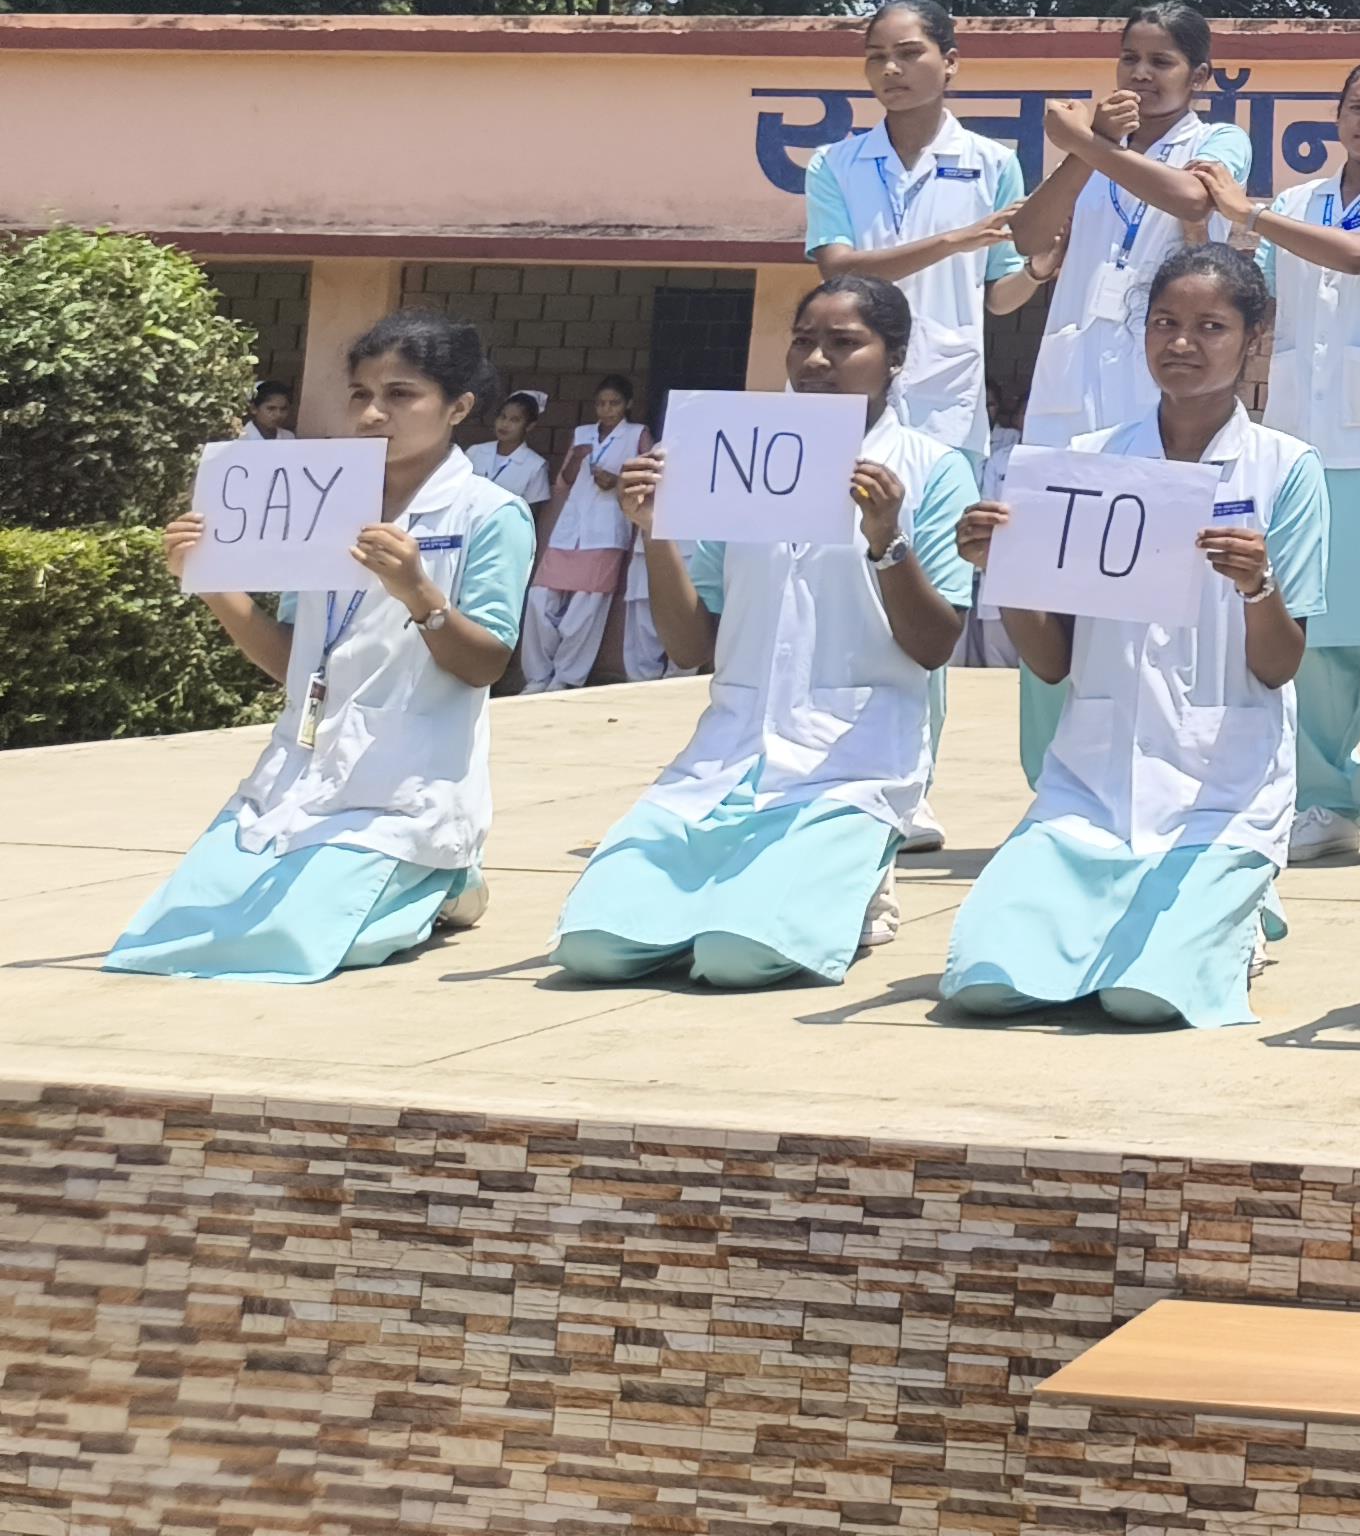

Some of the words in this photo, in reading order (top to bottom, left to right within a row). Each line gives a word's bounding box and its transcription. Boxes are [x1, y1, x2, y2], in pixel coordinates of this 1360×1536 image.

[710, 426, 804, 496] NO
[214, 465, 343, 544] SAY
[1045, 485, 1146, 578] TO
